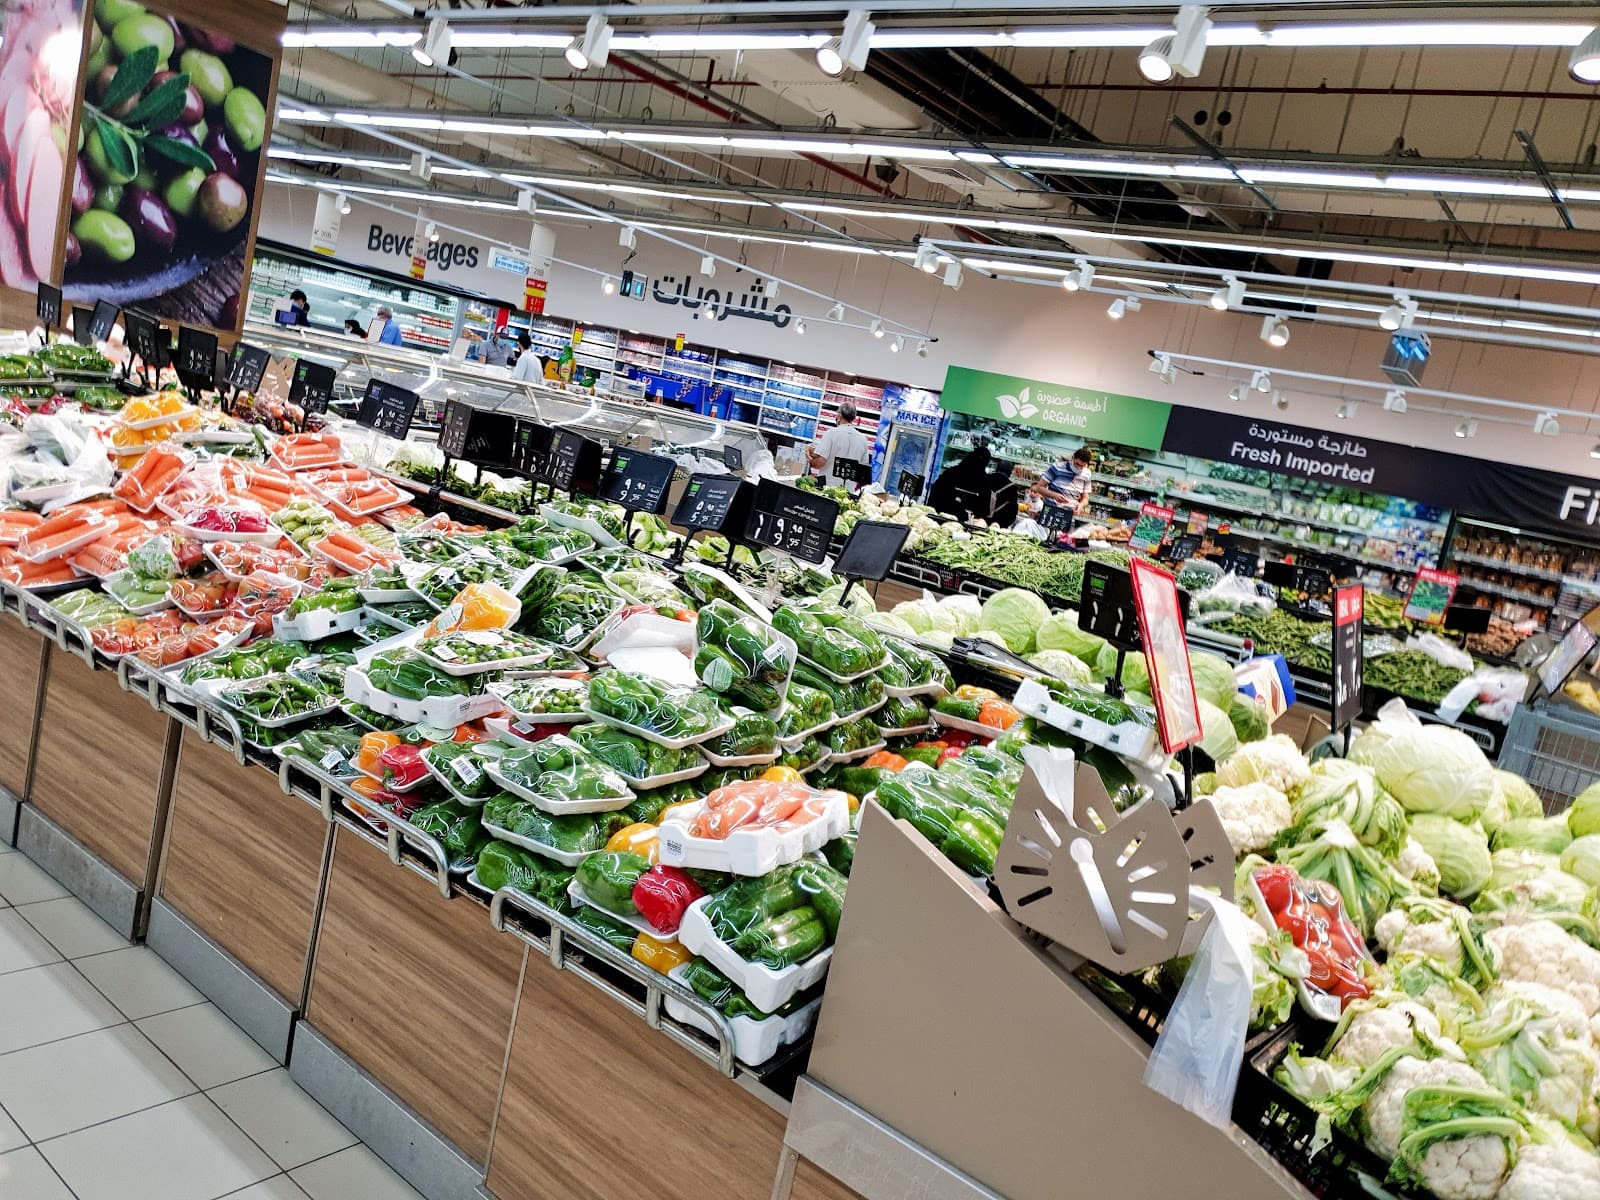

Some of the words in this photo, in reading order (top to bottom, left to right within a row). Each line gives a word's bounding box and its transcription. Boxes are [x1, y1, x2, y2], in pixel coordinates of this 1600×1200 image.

[367, 224, 480, 271] Beveages
[653, 275, 791, 328] مشروبات
[1036, 391, 1071, 409] عضوية
[1073, 399, 1107, 414] أطعمة
[896, 410, 916, 425] MAR
[917, 413, 937, 427] ICE
[1042, 408, 1088, 428] ORGANIC
[1249, 423, 1314, 449] مستوردة
[1318, 435, 1368, 458] طازجة
[1231, 442, 1282, 466] Fresh
[1285, 452, 1376, 484] Imported
[1559, 485, 1600, 526] Fi
